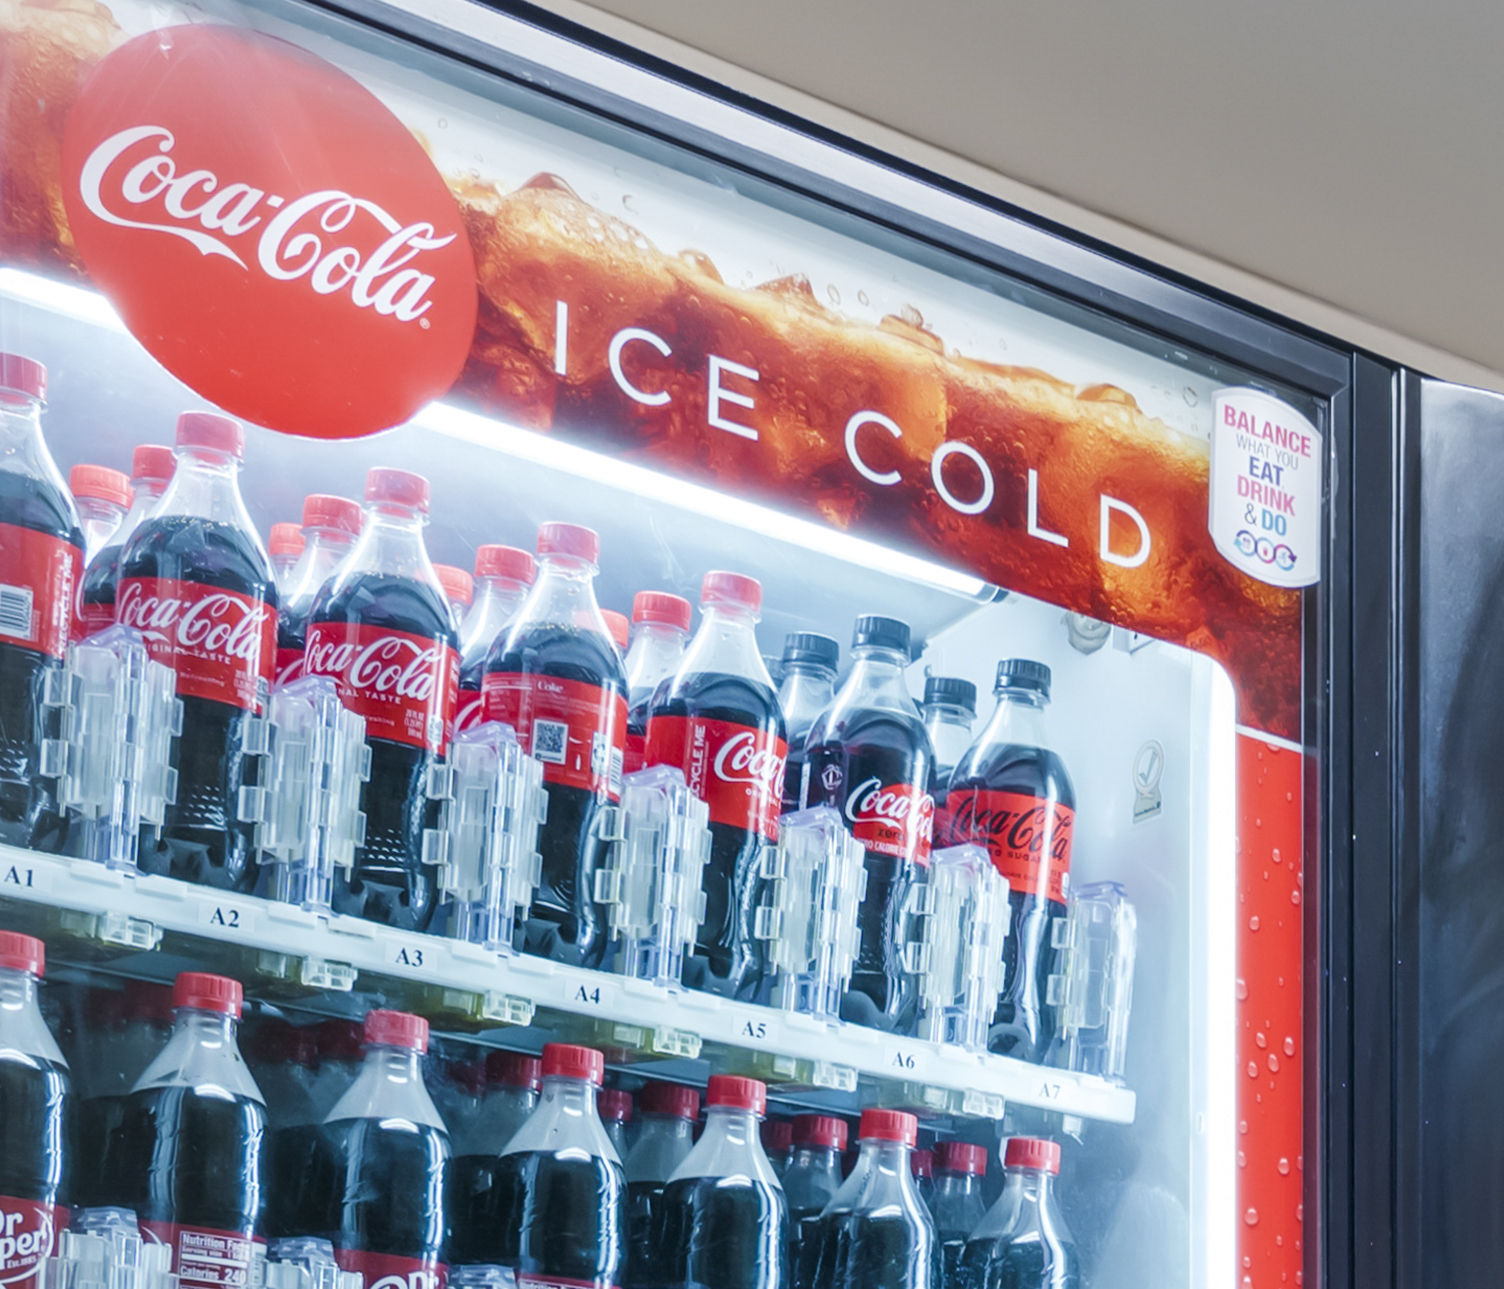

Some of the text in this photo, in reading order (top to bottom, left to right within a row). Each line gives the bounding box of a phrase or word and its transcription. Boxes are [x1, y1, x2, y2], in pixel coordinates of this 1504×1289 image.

[79, 123, 456, 326] Coca-Cola
[556, 300, 1151, 571] ICE COLD
[1224, 404, 1311, 458] BALANCE
[1236, 433, 1298, 470] WHAT YOU
[1237, 475, 1295, 516] DRINK
[1245, 503, 1287, 536] & DO
[117, 582, 269, 661] Coca-Cola
[304, 629, 442, 701] Coca-Cola
[537, 679, 564, 694] Coke
[364, 690, 402, 705] TASTE
[4, 866, 35, 888] A1
[210, 907, 240, 928] A2
[395, 946, 424, 967] A3
[574, 984, 601, 1005] A4
[741, 1019, 767, 1040] A5
[892, 1051, 916, 1072] A6
[1039, 1081, 1061, 1101] A7
[182, 1233, 225, 1250] Nutrition
[180, 1265, 246, 1284] Calories 240
